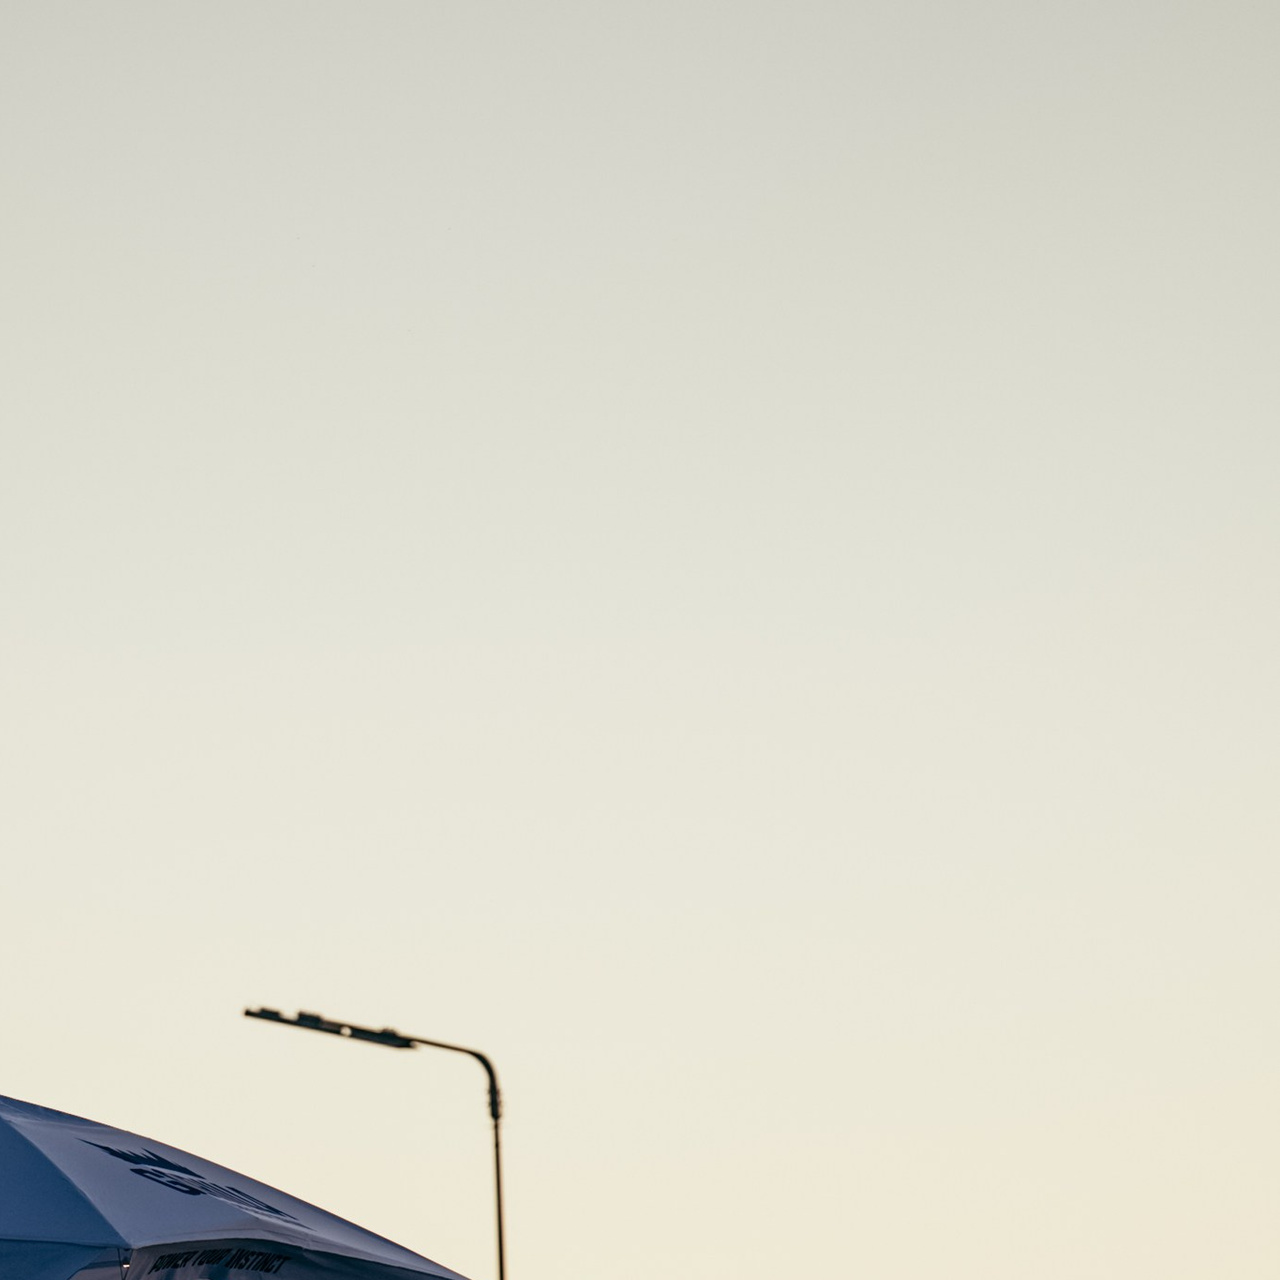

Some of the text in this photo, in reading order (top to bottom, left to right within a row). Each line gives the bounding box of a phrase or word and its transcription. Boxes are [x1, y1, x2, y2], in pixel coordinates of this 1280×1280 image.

[148, 1248, 292, 1275] POWER YOUR INSTINCT
